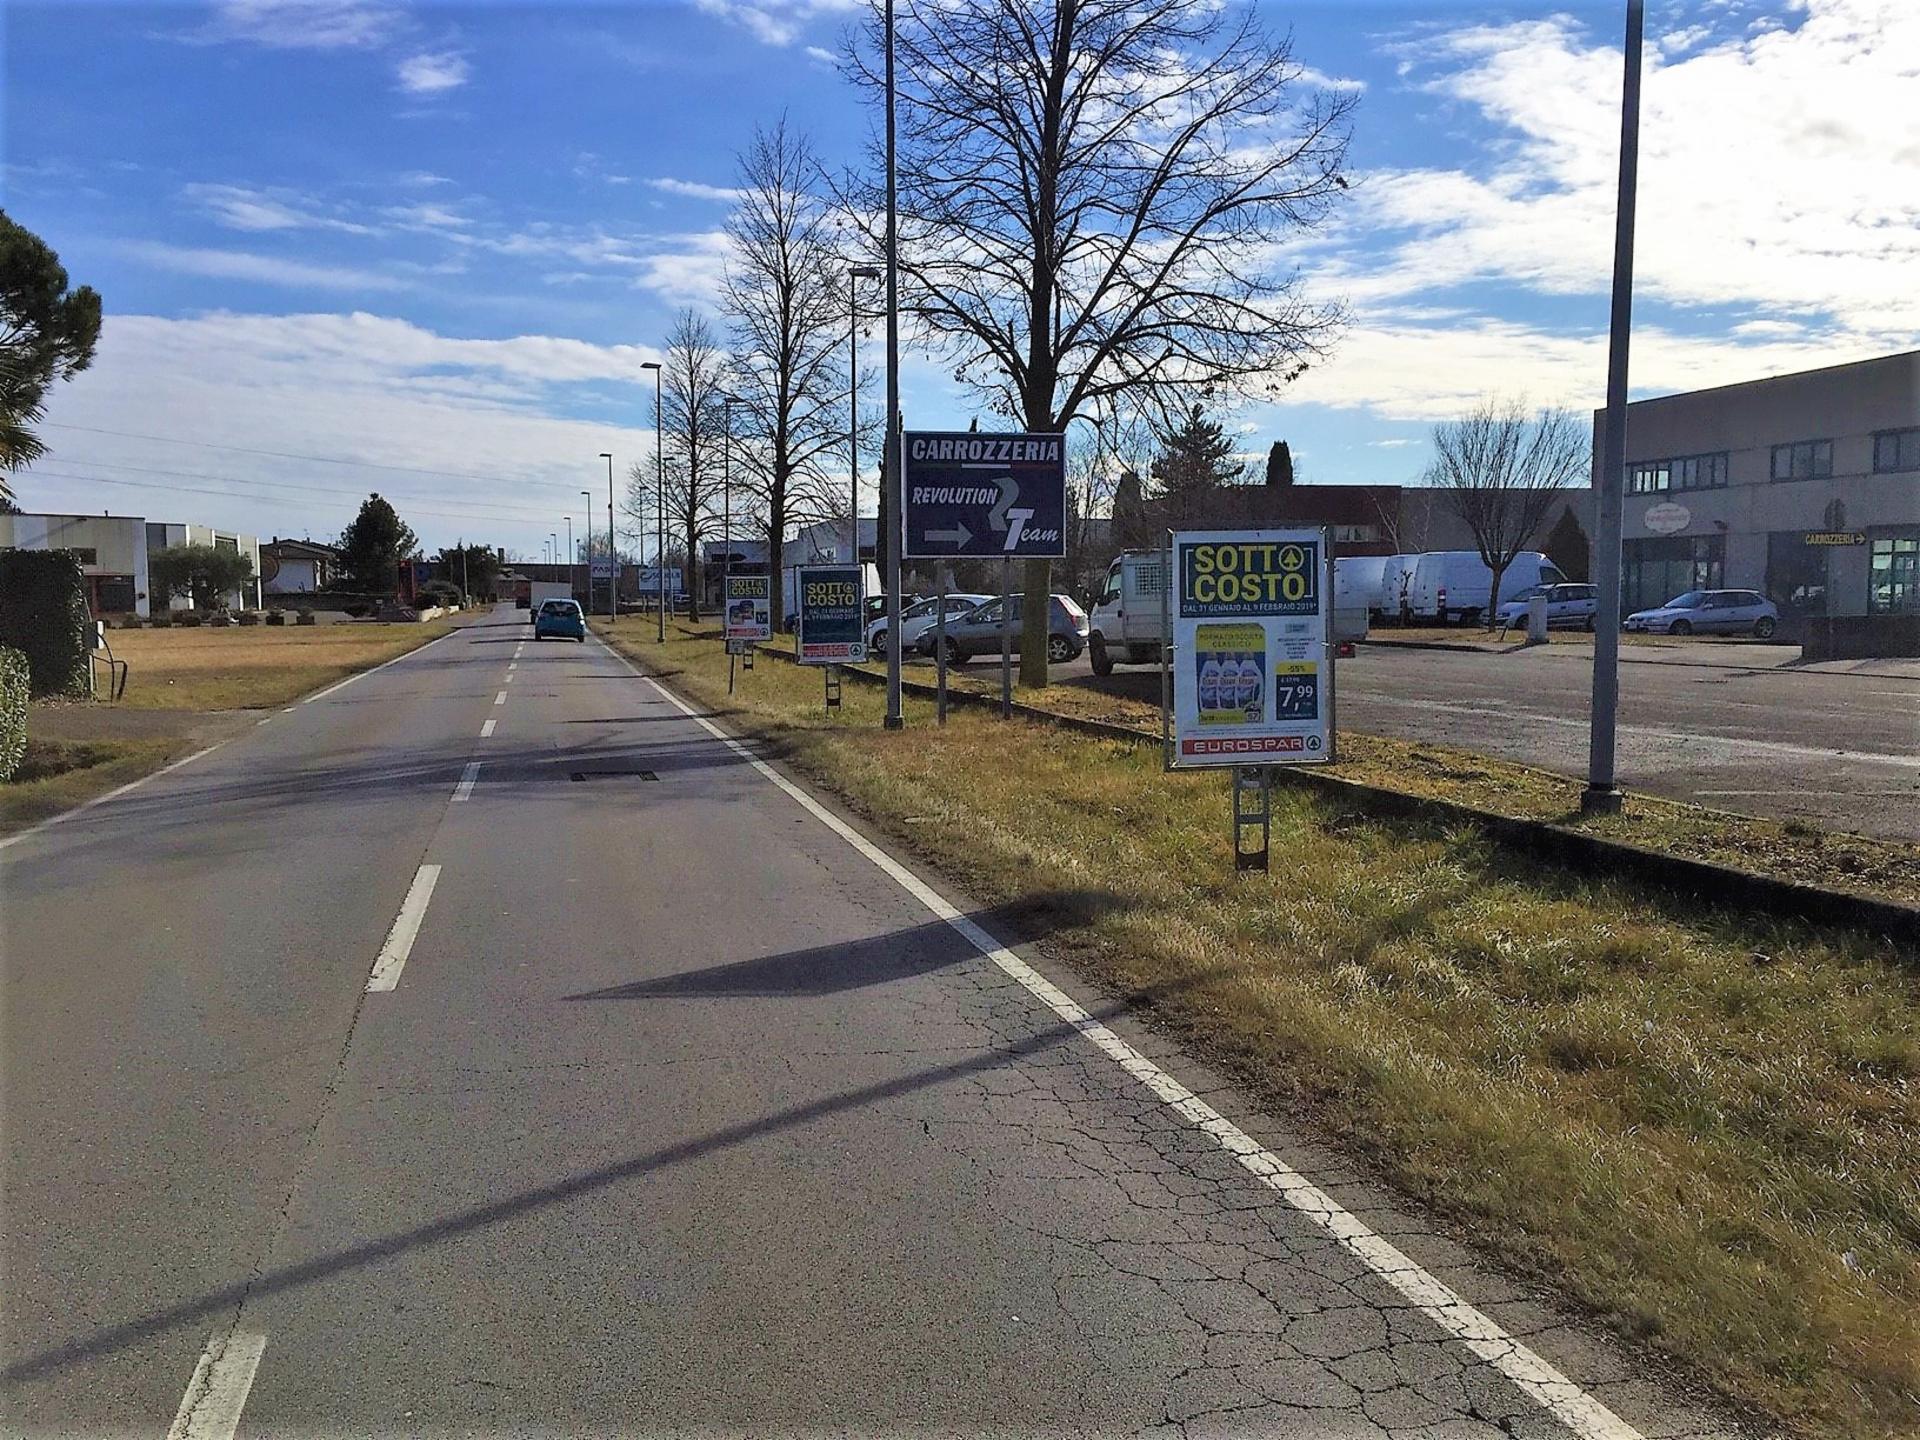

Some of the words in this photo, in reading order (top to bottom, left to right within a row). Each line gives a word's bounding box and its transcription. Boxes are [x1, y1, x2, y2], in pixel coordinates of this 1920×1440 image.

[911, 439, 1059, 461] CARROZZERIA
[912, 486, 999, 505] REVOLUTION
[731, 587, 764, 595] COSTO
[1194, 573, 1306, 603] COSTO
[807, 593, 855, 606] COSTO
[1183, 604, 1197, 613] DAL
[1209, 604, 1242, 612] GENNAIO
[1242, 603, 1252, 611] AL
[1279, 684, 1314, 711] 7,99
[1193, 738, 1303, 753] EUROSPAR
